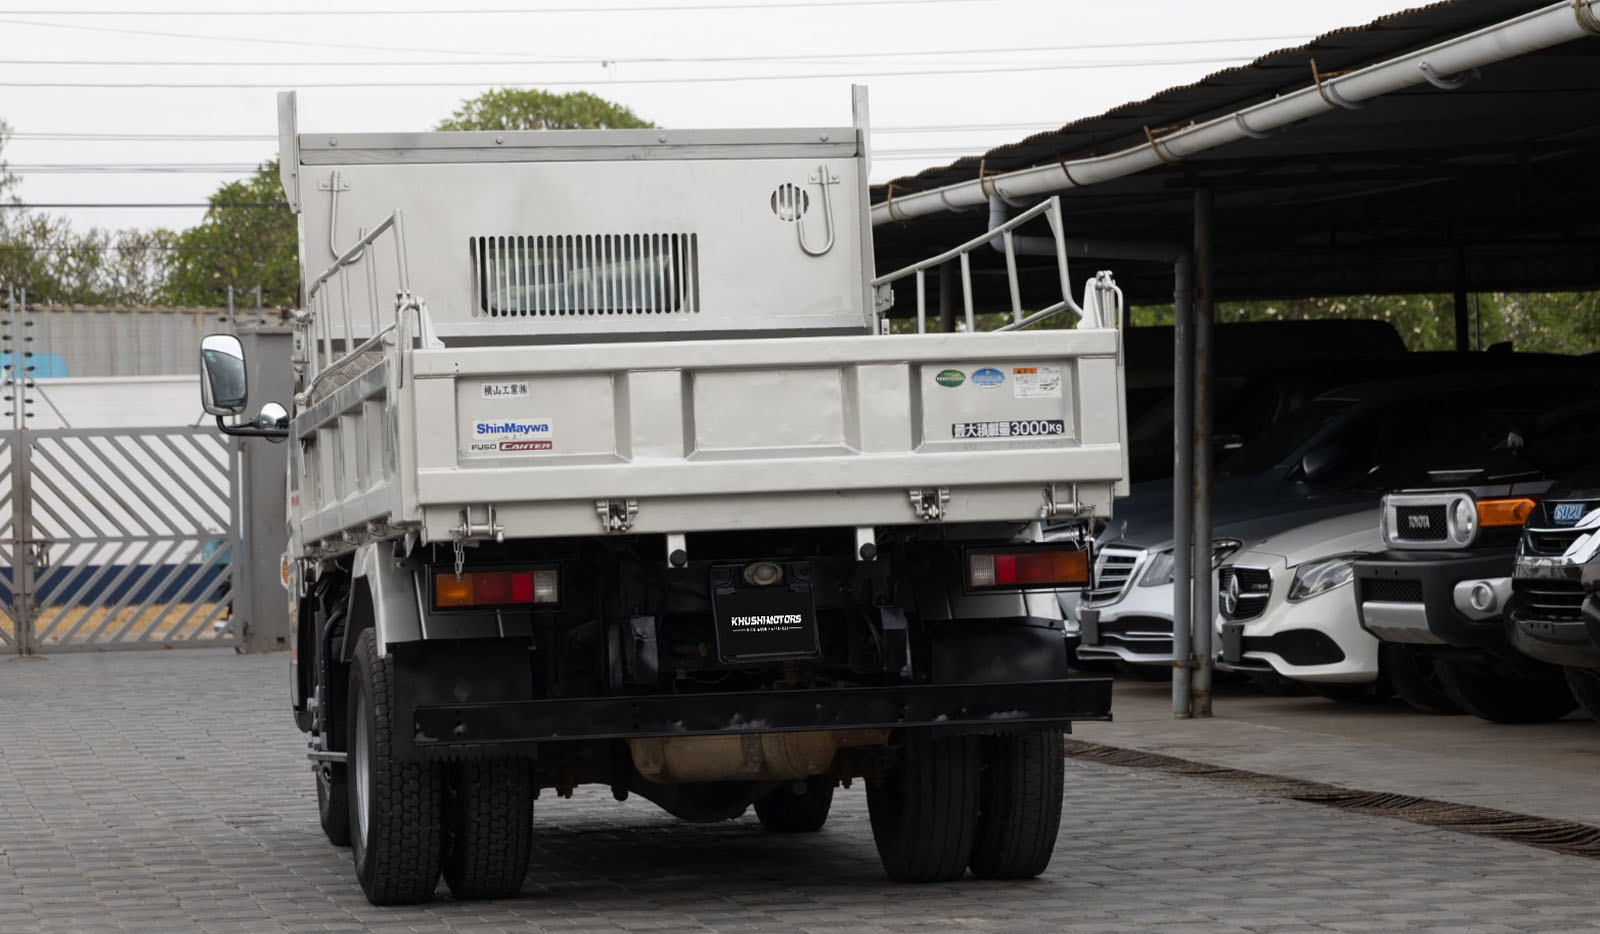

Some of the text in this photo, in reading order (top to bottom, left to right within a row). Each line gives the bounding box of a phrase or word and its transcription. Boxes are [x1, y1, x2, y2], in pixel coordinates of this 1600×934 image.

[476, 422, 549, 435] ShinMaywa
[471, 443, 497, 451] FUSO
[1553, 504, 1584, 520] ISUZU
[1408, 515, 1431, 528] TOYOTA
